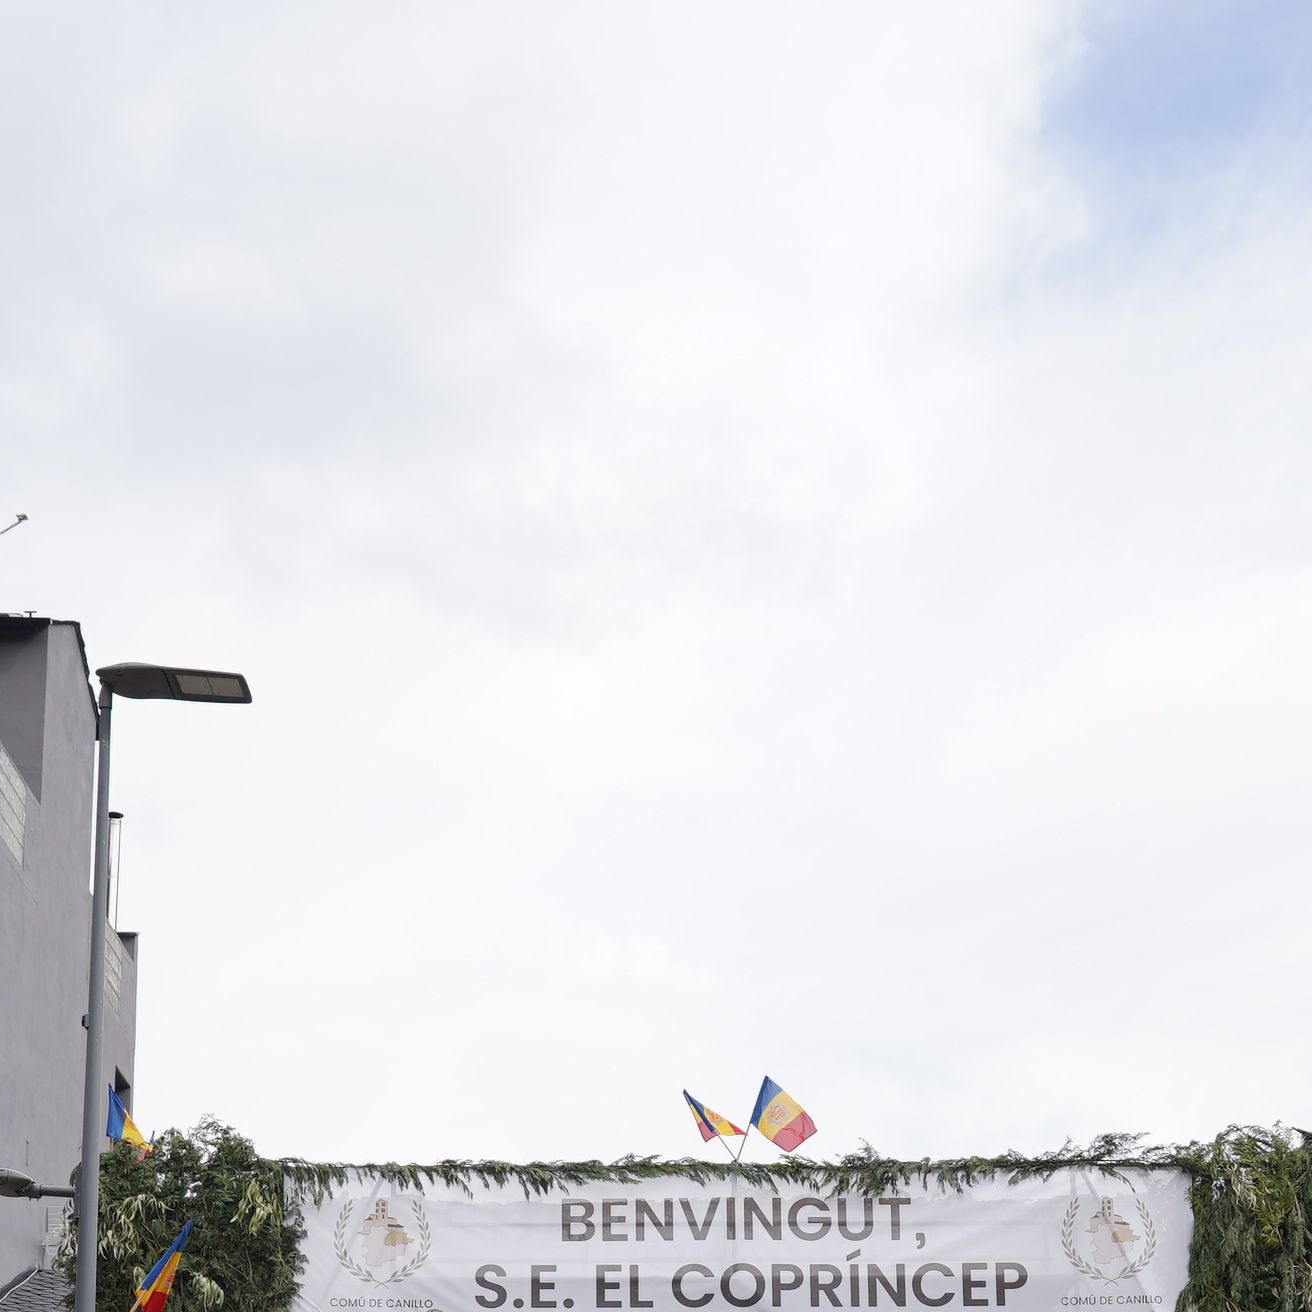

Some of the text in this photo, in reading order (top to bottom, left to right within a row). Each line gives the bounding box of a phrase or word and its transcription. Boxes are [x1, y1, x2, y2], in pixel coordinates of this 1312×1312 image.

[561, 1197, 926, 1249] BENVINGUT,
[474, 1248, 1028, 1309] S.E. EL COPRÍNCEP
[329, 1296, 433, 1308] COMÚ DE CANILLO
[1060, 1294, 1163, 1306] COMÚ DE CANILLO
